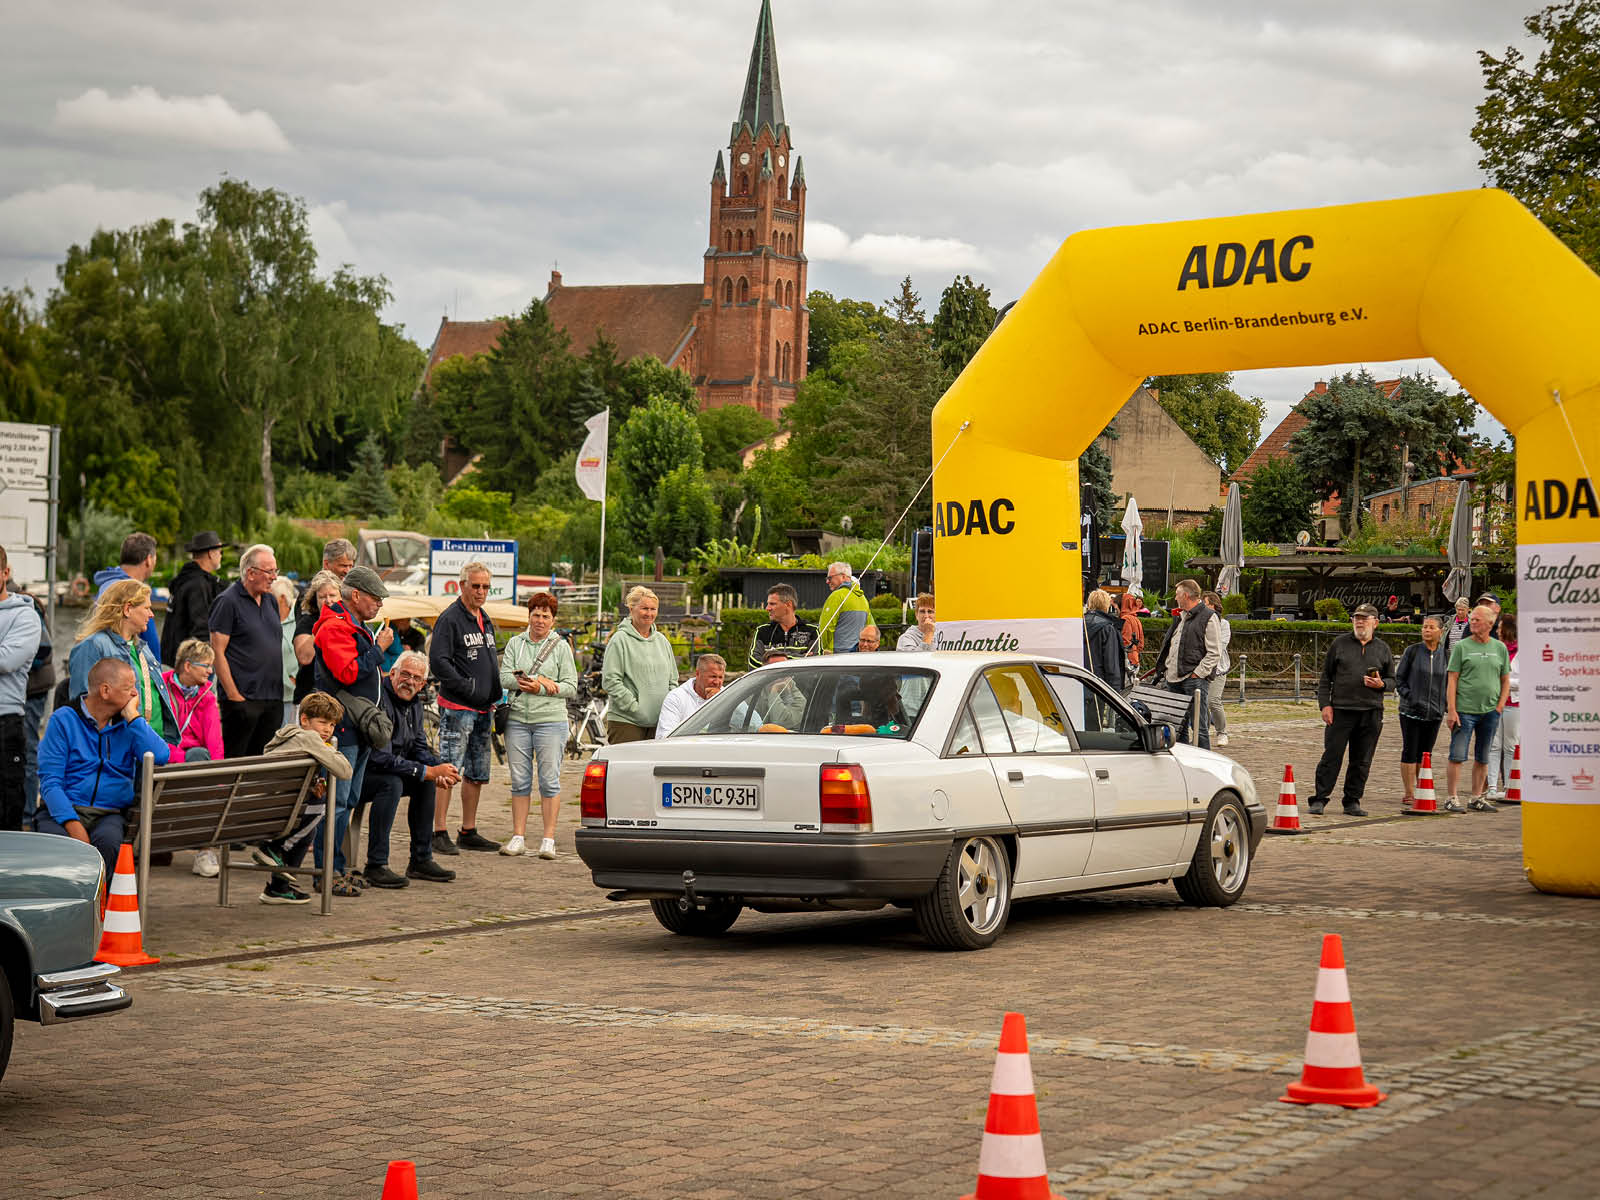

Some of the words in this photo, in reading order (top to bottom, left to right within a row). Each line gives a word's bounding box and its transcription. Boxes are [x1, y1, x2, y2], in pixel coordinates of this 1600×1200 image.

[1177, 234, 1314, 291] ADAC
[1138, 321, 1180, 335] ADAC
[1184, 311, 1336, 333] Berlin-Brandenburg
[1340, 307, 1368, 321] e.V.
[1524, 478, 1600, 520] ADA
[935, 498, 1015, 538] ADAC
[442, 540, 506, 552] Restaurant
[1302, 585, 1408, 607] Willkommn
[1353, 582, 1396, 593] Herzlich
[936, 630, 1019, 651] Landpartie
[1563, 712, 1600, 723] DEKRA
[673, 786, 703, 804] SPN
[713, 787, 723, 805] C
[726, 788, 756, 806] 93H
